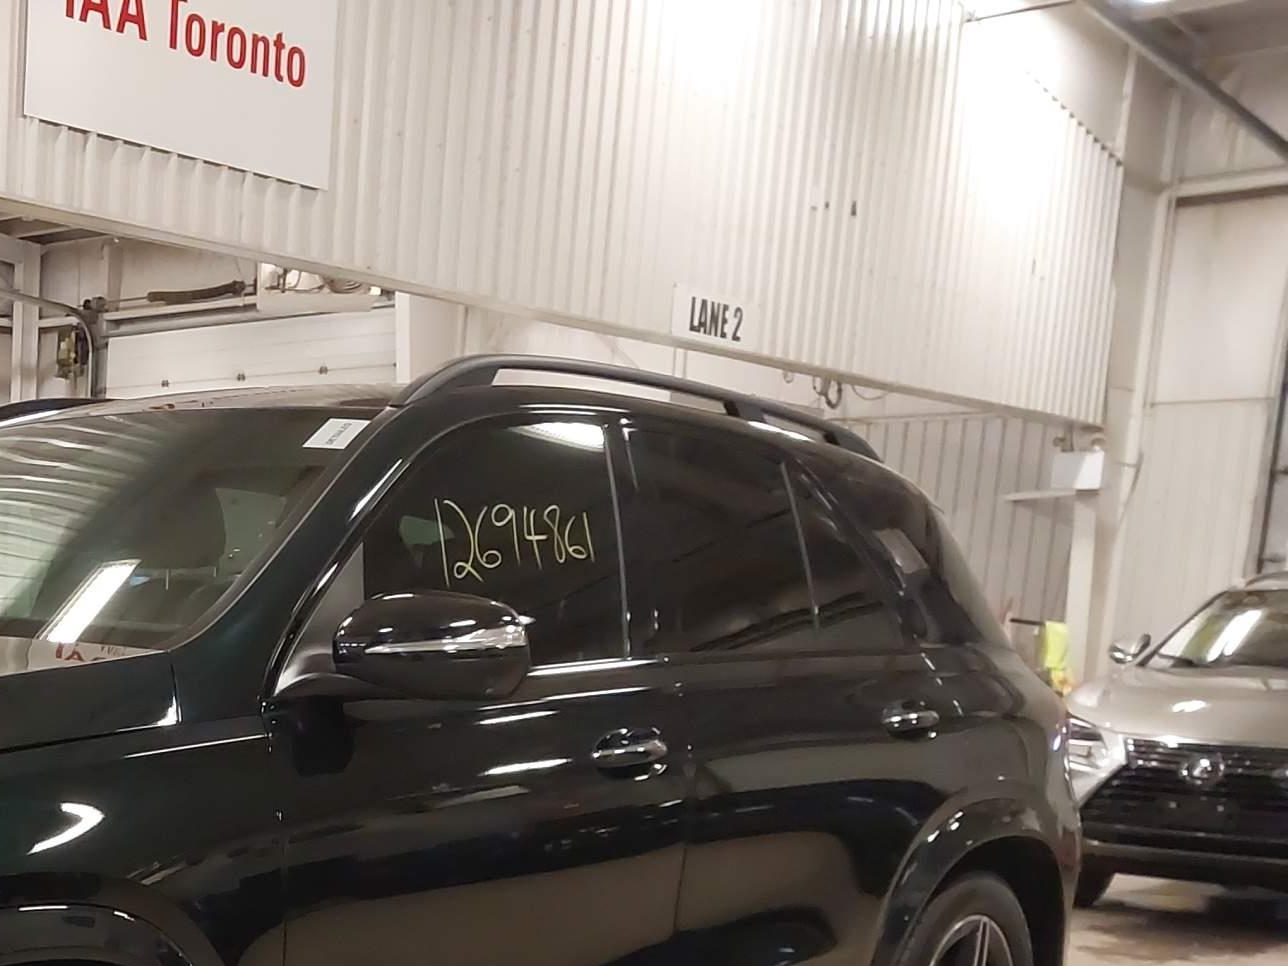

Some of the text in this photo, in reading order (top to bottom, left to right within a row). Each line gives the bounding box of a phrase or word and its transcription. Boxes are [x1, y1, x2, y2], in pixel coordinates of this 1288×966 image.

[168, 0, 306, 88] Toronto
[689, 296, 743, 342] LANE 2
[434, 498, 596, 588] 12694861
